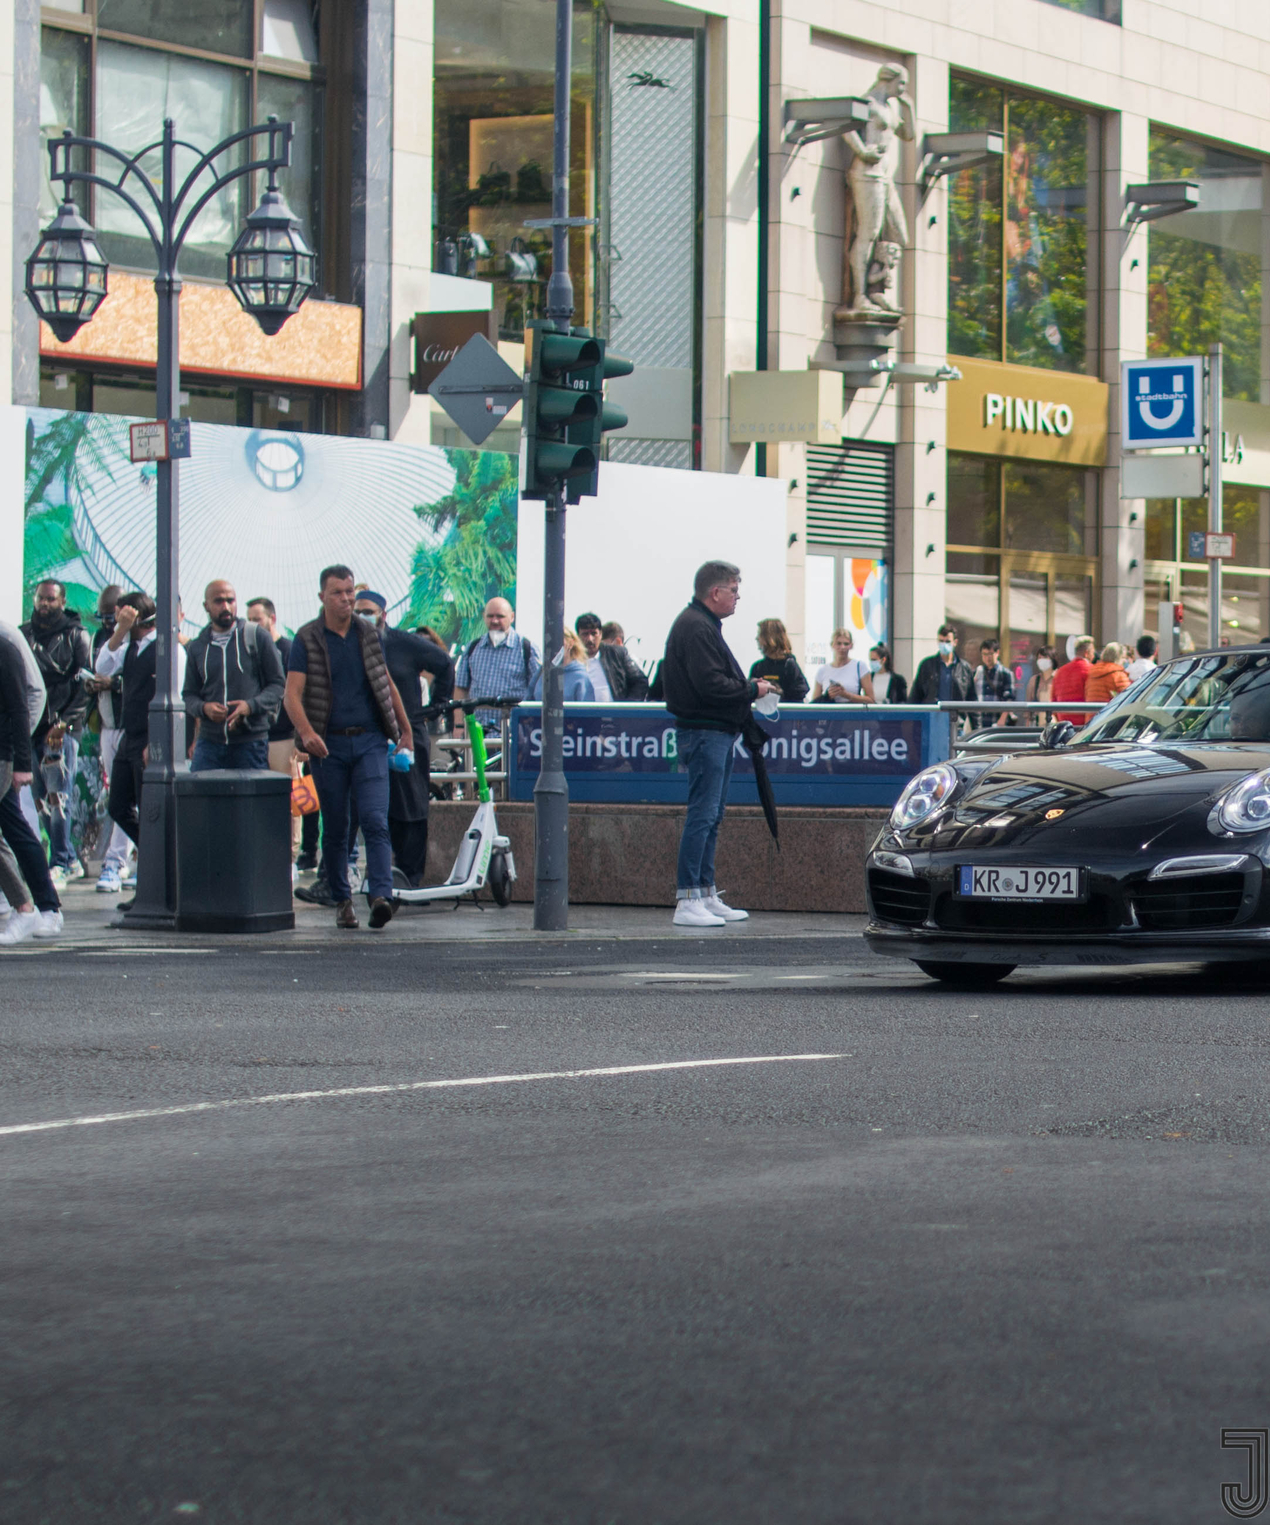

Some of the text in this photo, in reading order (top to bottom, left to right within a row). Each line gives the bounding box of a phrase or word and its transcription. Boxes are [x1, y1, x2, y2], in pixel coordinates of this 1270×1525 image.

[422, 342, 460, 364] Cart
[1135, 391, 1188, 402] stadtbahn
[984, 392, 1074, 437] PINKO
[529, 727, 908, 768] Seinstraß Knigsallee
[973, 869, 1001, 893] KR
